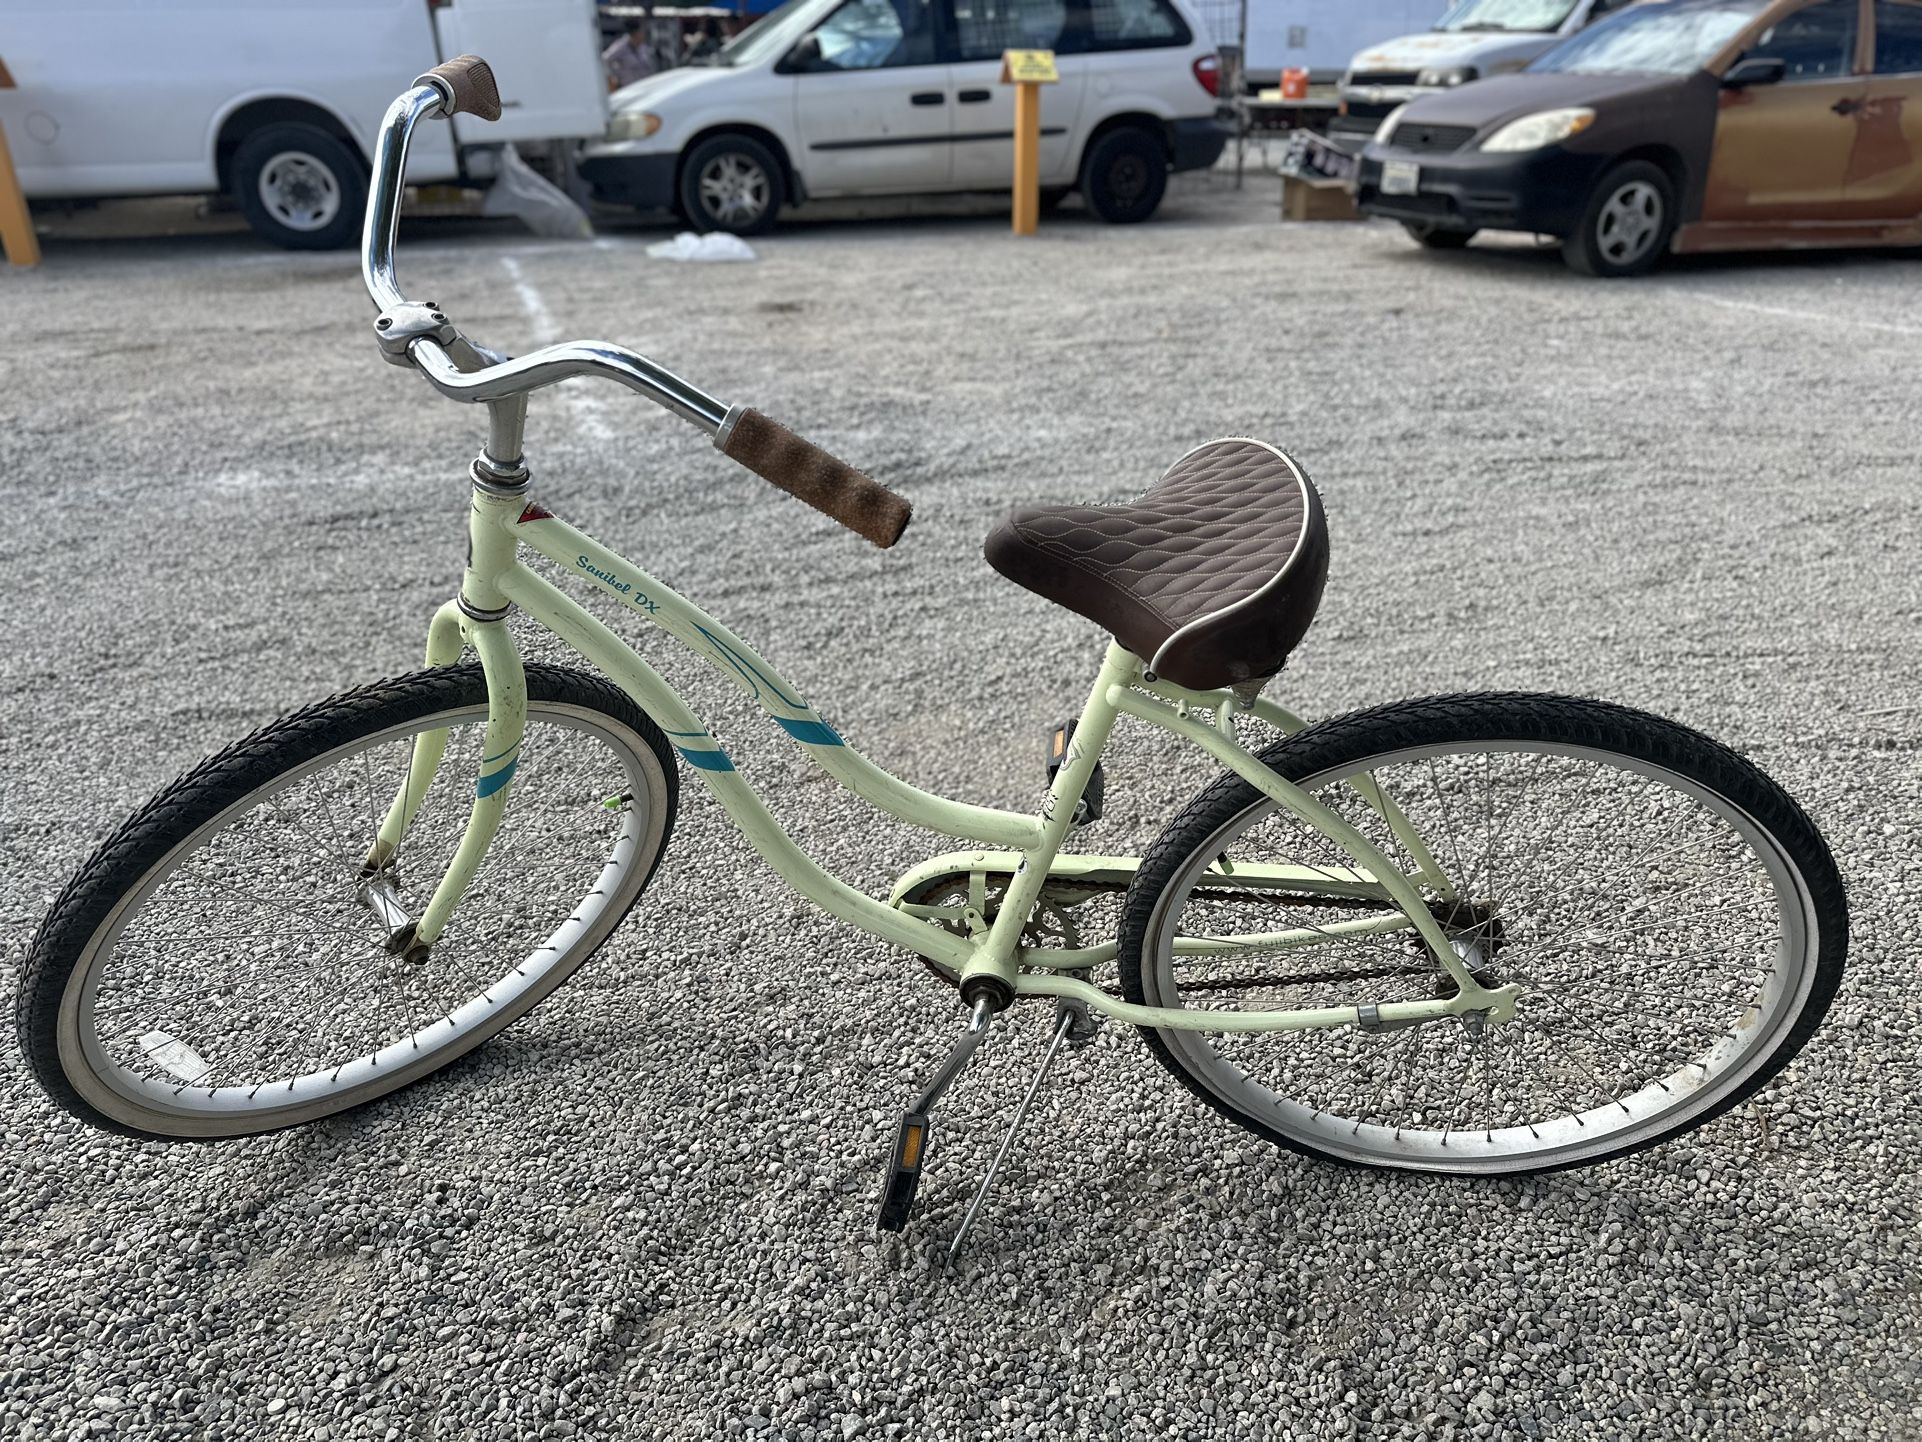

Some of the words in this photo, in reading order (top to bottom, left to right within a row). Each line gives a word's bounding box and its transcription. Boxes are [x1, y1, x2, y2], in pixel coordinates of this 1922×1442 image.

[576, 555, 632, 595] Sanibel
[634, 592, 661, 615] DX
[1214, 929, 1369, 954] www.fujibikescom
